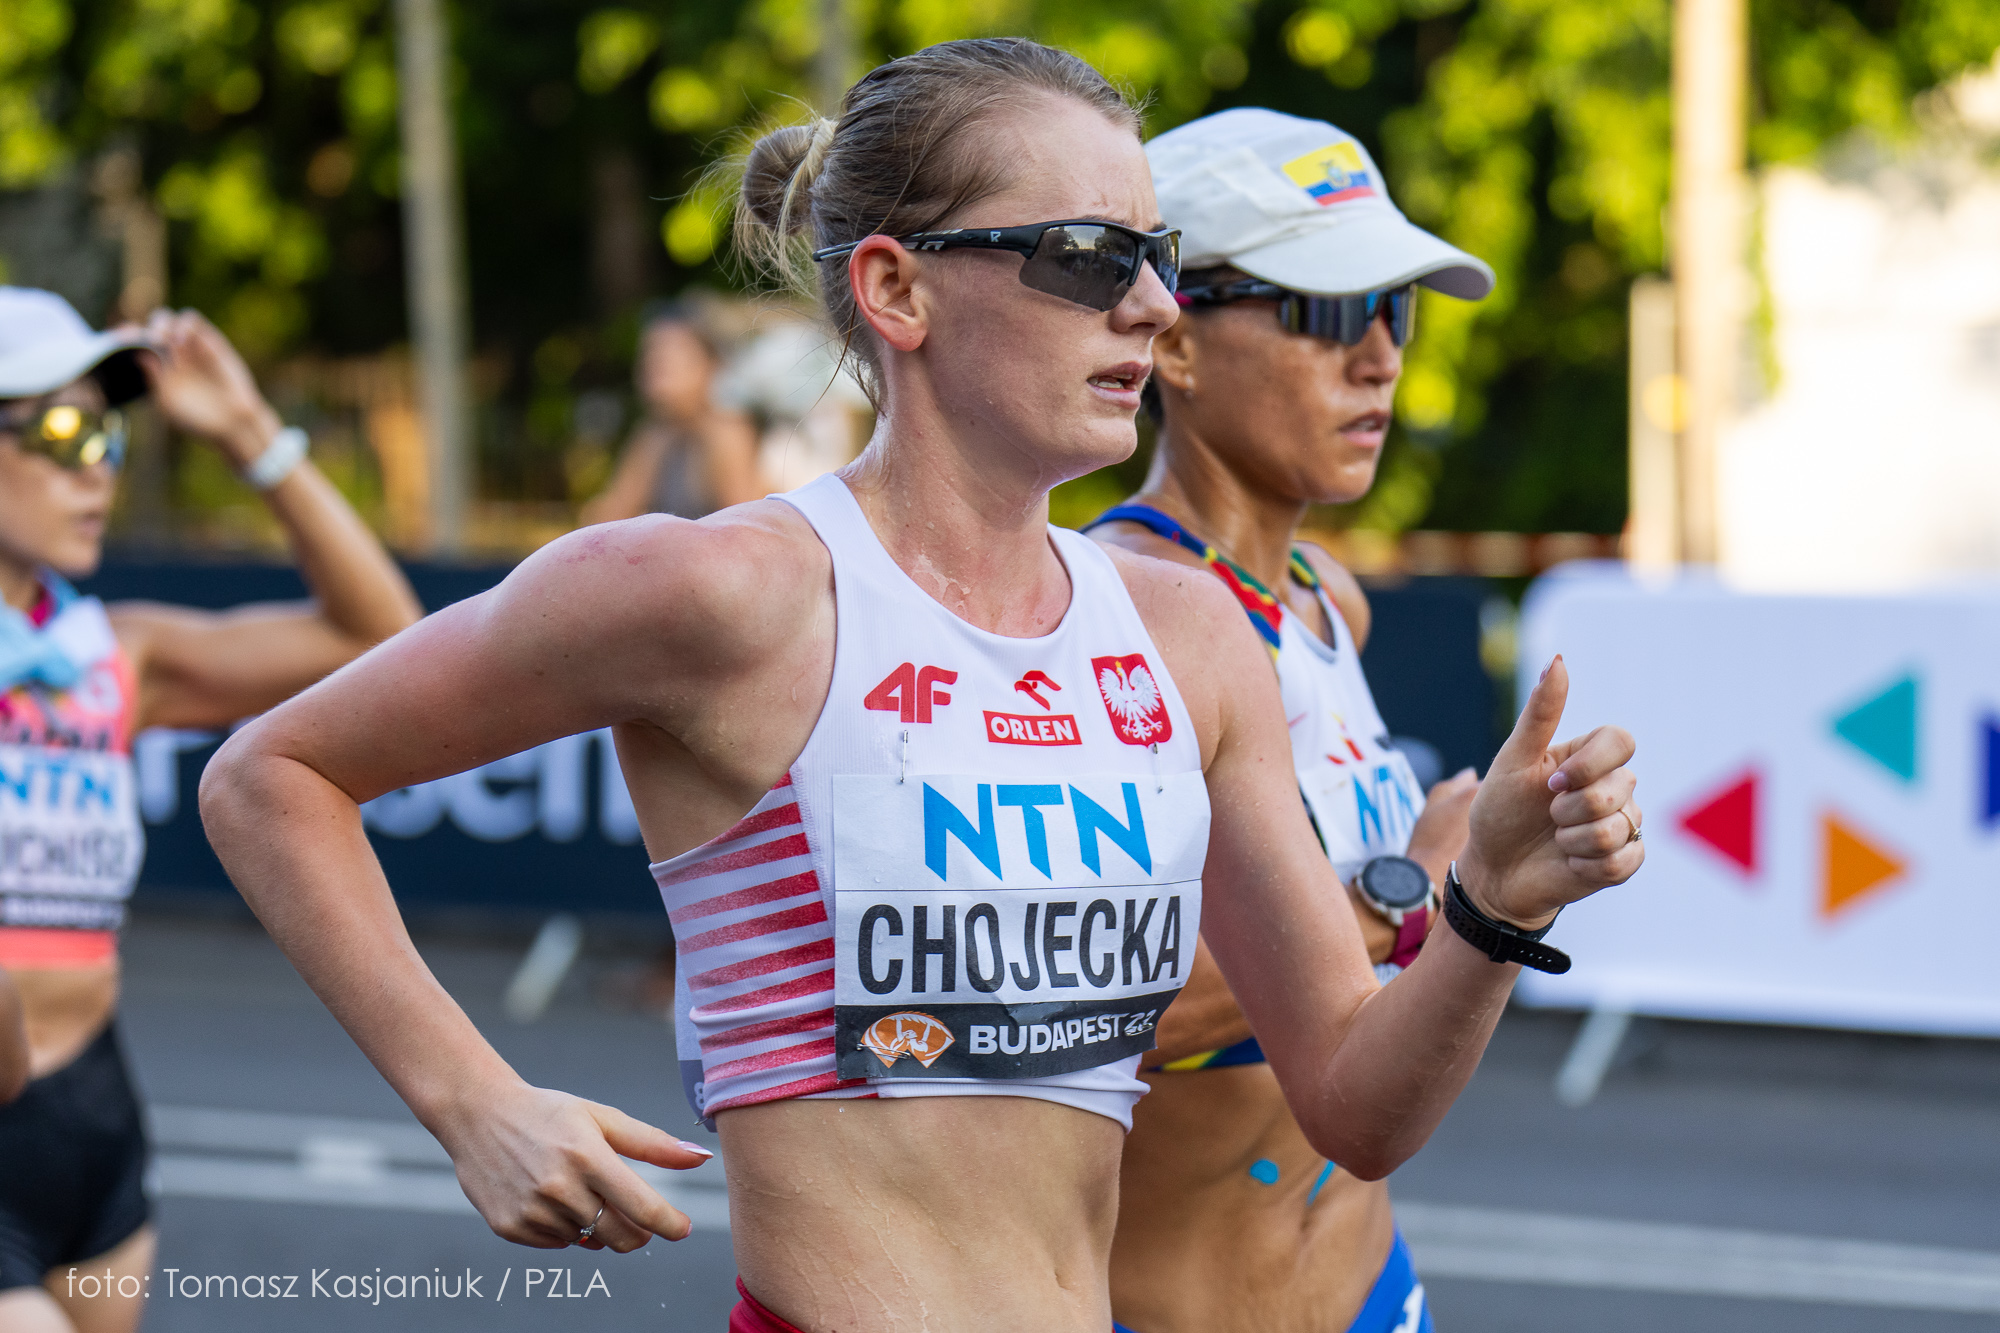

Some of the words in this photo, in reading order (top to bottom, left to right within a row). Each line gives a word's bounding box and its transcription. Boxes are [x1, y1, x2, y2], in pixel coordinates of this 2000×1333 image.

[864, 662, 958, 723] 4F
[990, 716, 1075, 742] ORLEN
[923, 781, 1153, 882] NTN
[857, 895, 1181, 995] CHOJECKA
[969, 1013, 1129, 1055] BUDAPEST
